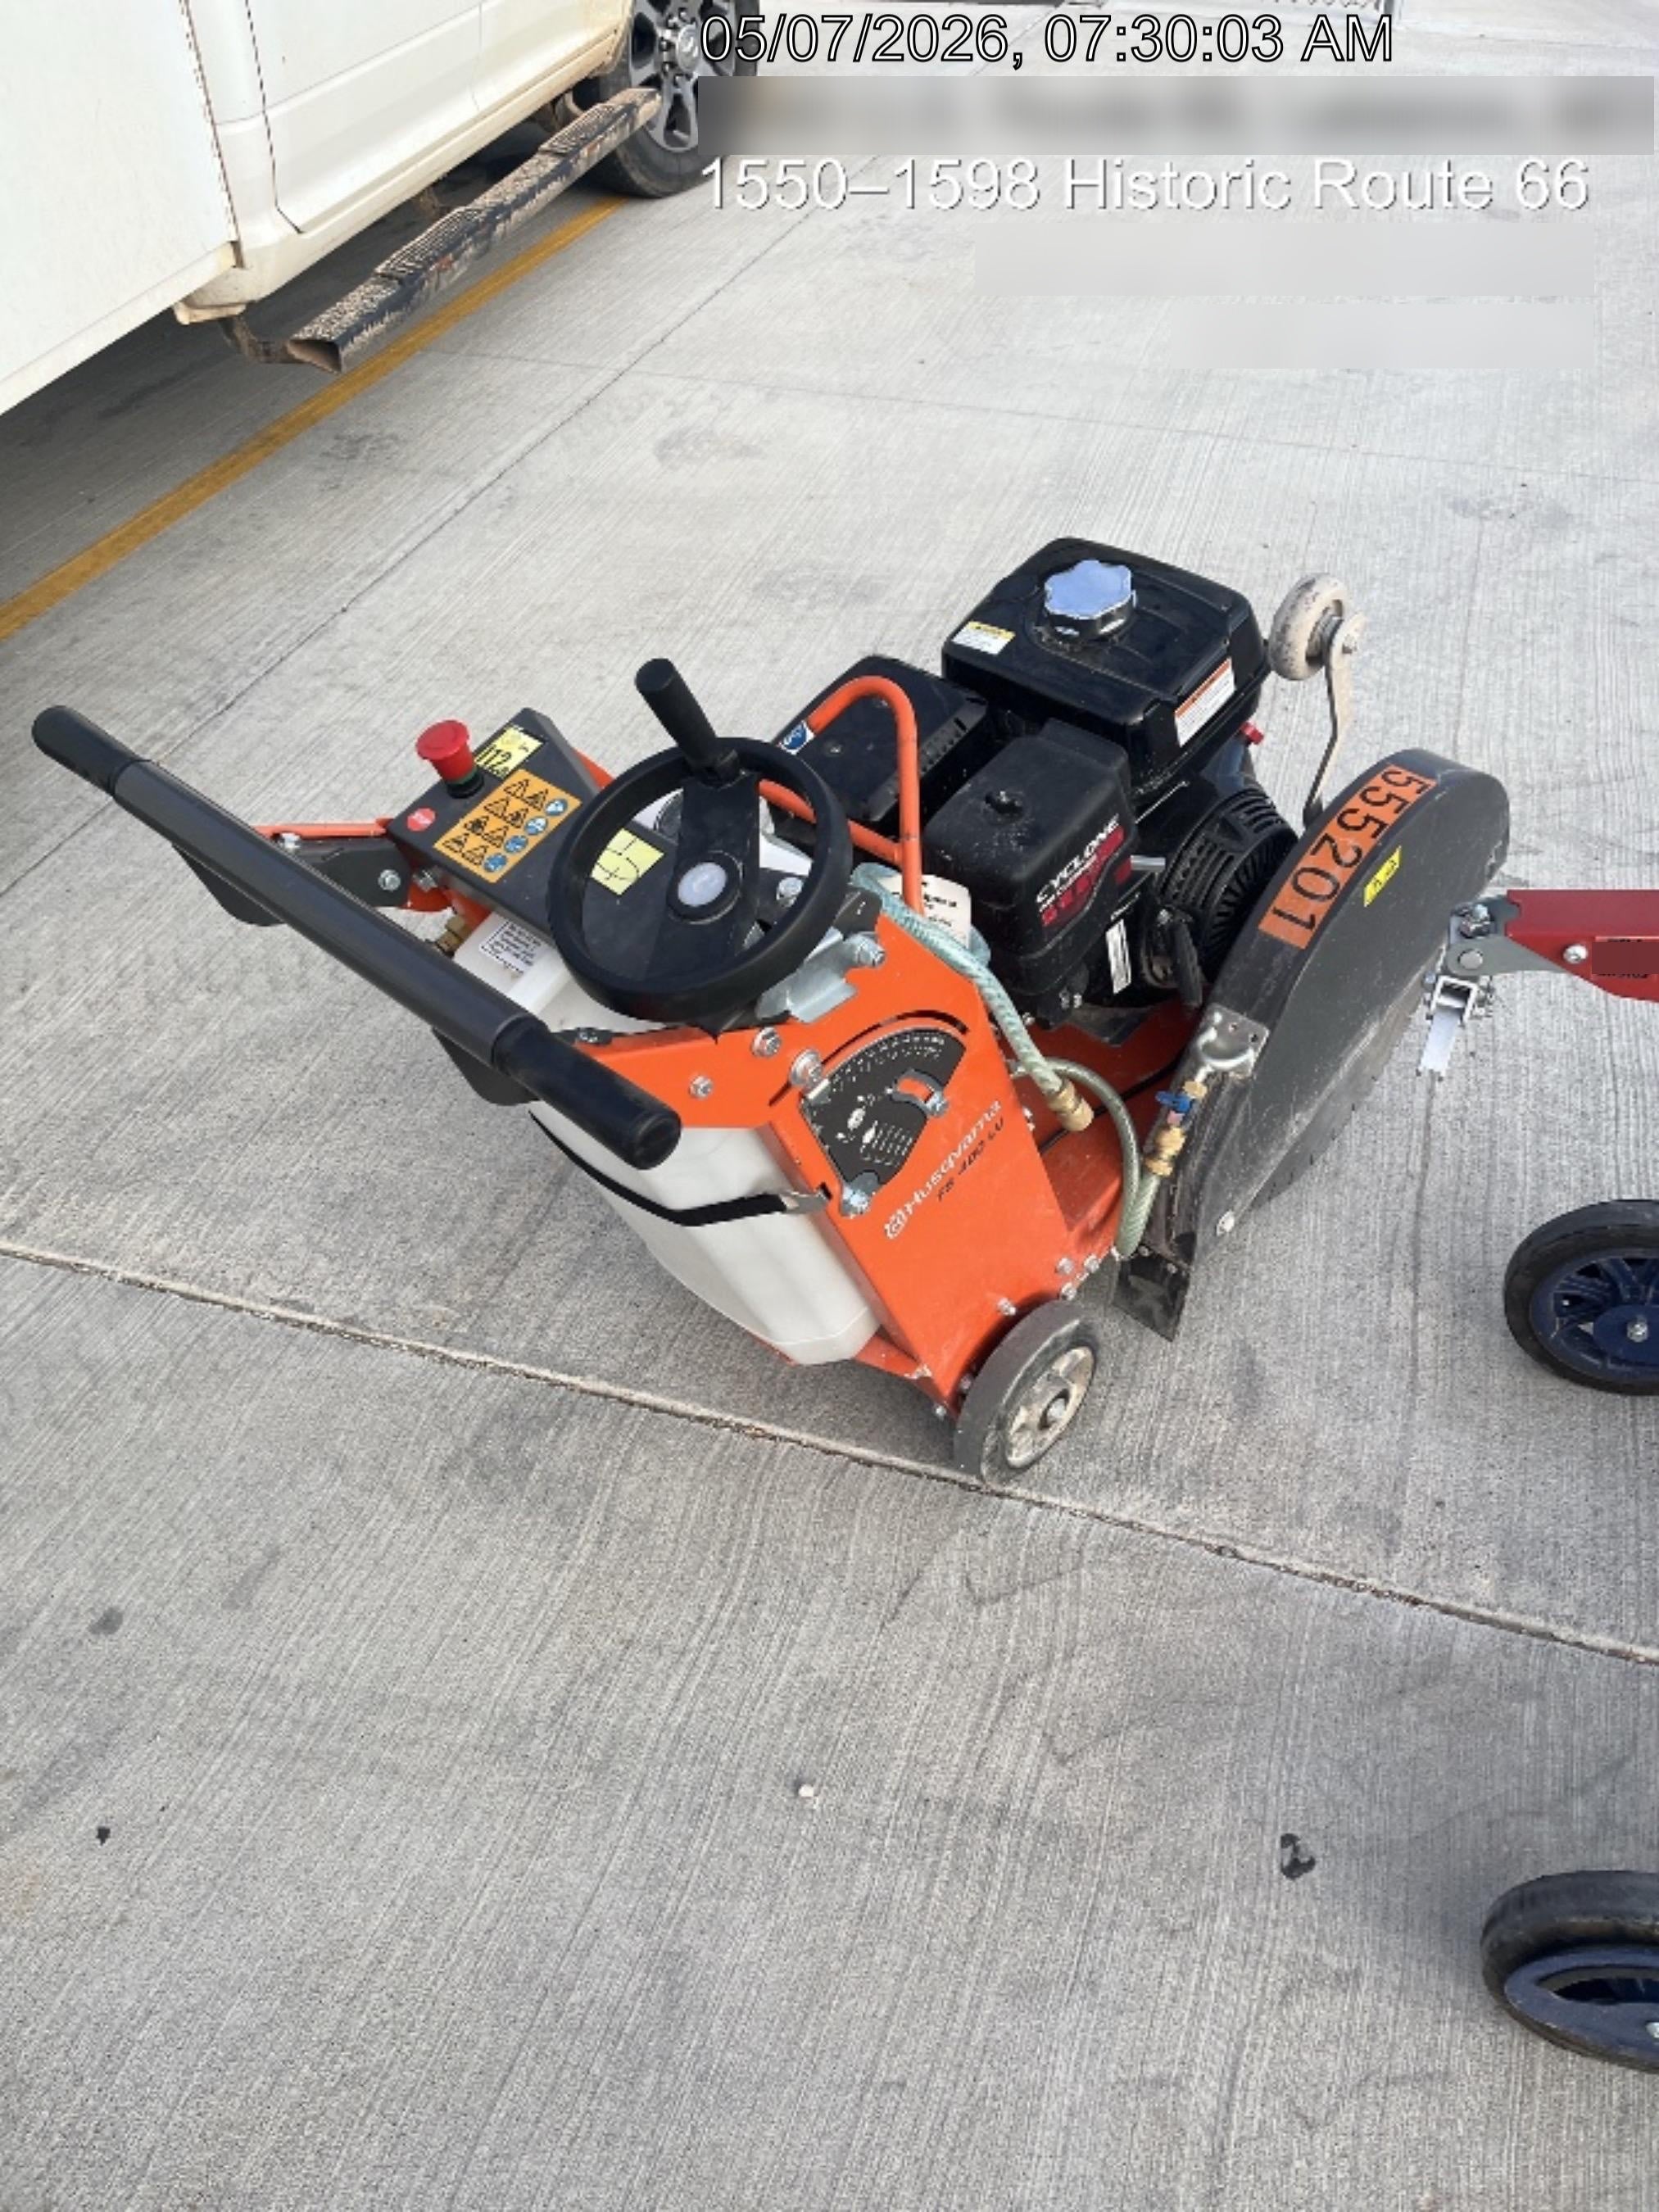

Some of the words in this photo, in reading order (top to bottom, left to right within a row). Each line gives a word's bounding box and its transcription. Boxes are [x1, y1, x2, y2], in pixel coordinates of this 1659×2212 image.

[1036, 813, 1120, 904] CYCLONE
[1271, 769, 1430, 931] 555201
[904, 1100, 1002, 1216] Husqvarna
